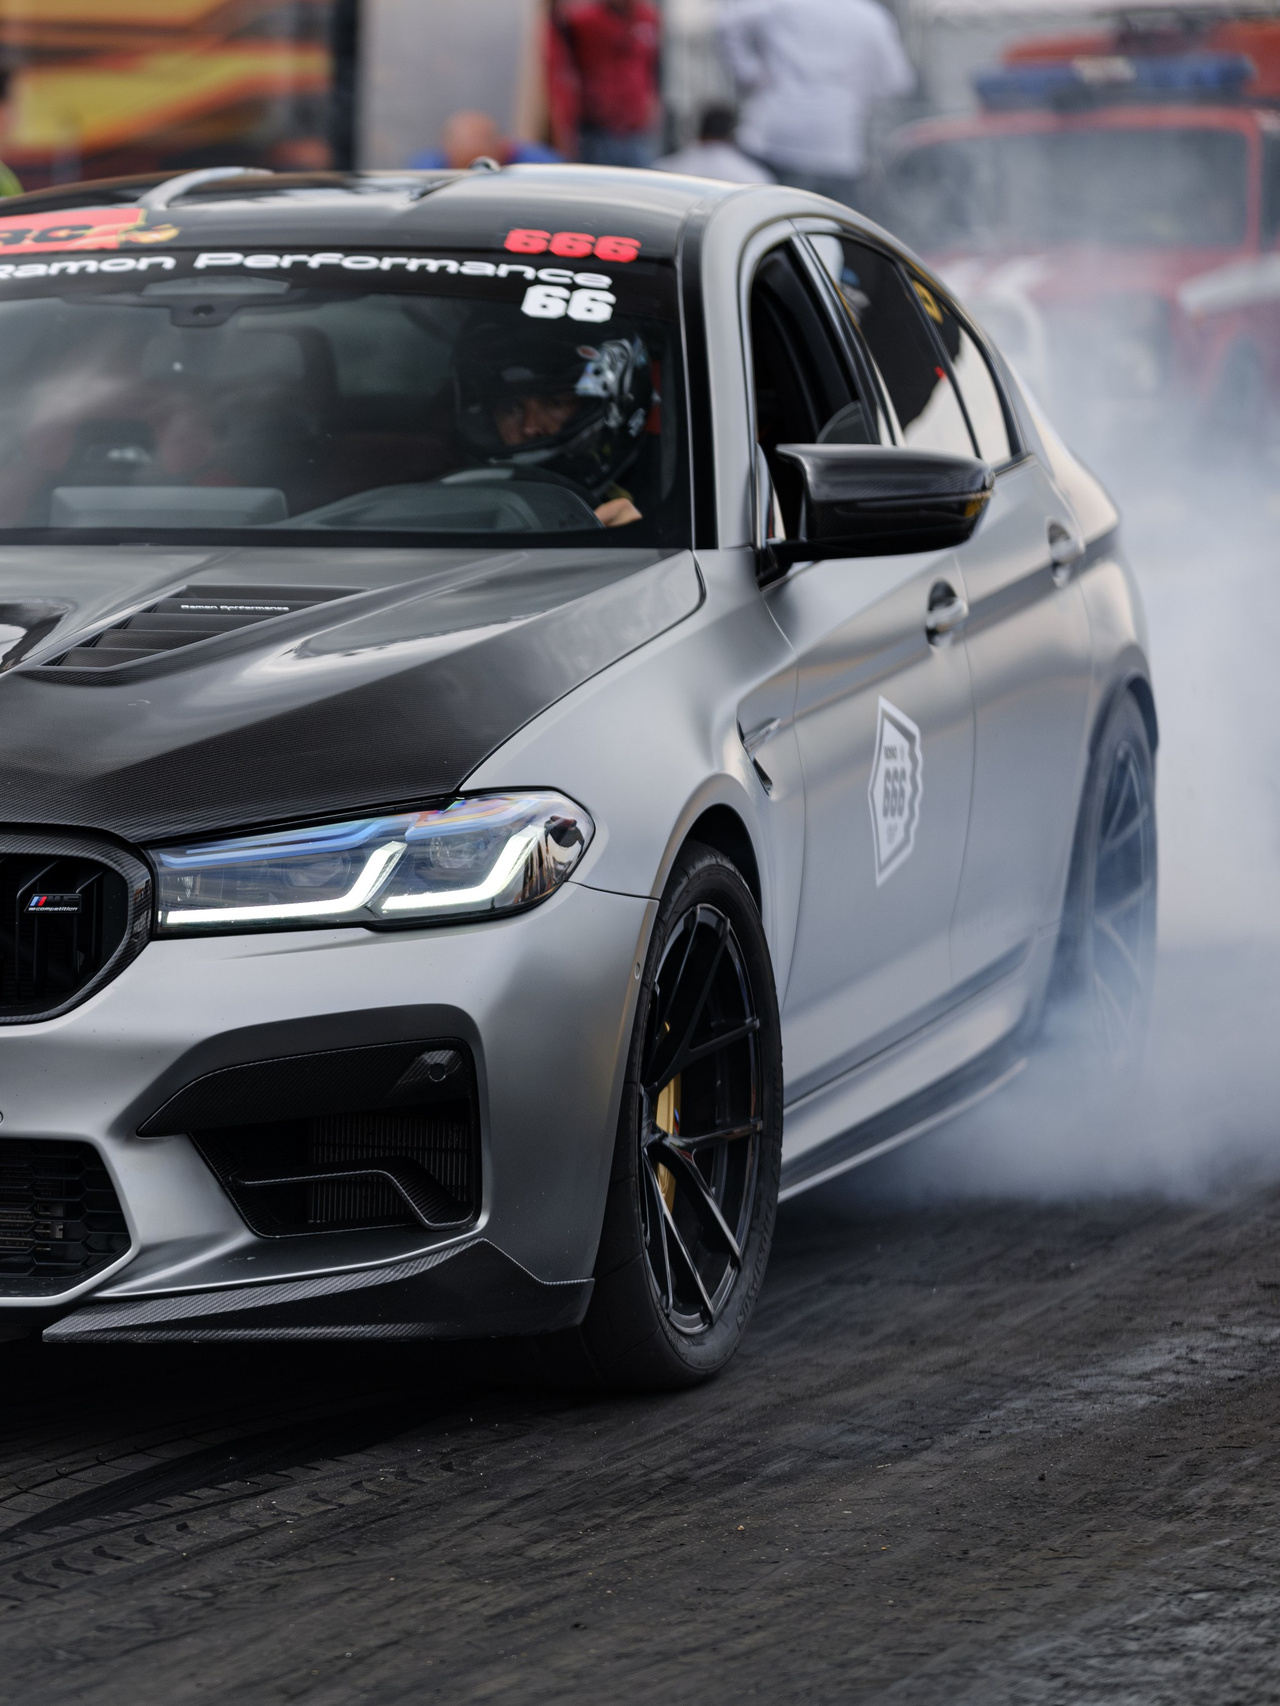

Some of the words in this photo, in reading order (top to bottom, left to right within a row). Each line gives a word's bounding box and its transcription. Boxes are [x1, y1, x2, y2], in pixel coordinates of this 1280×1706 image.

[504, 229, 641, 262] 666
[194, 252, 613, 289] Performance
[521, 284, 616, 323] 66
[882, 766, 907, 819] 666
